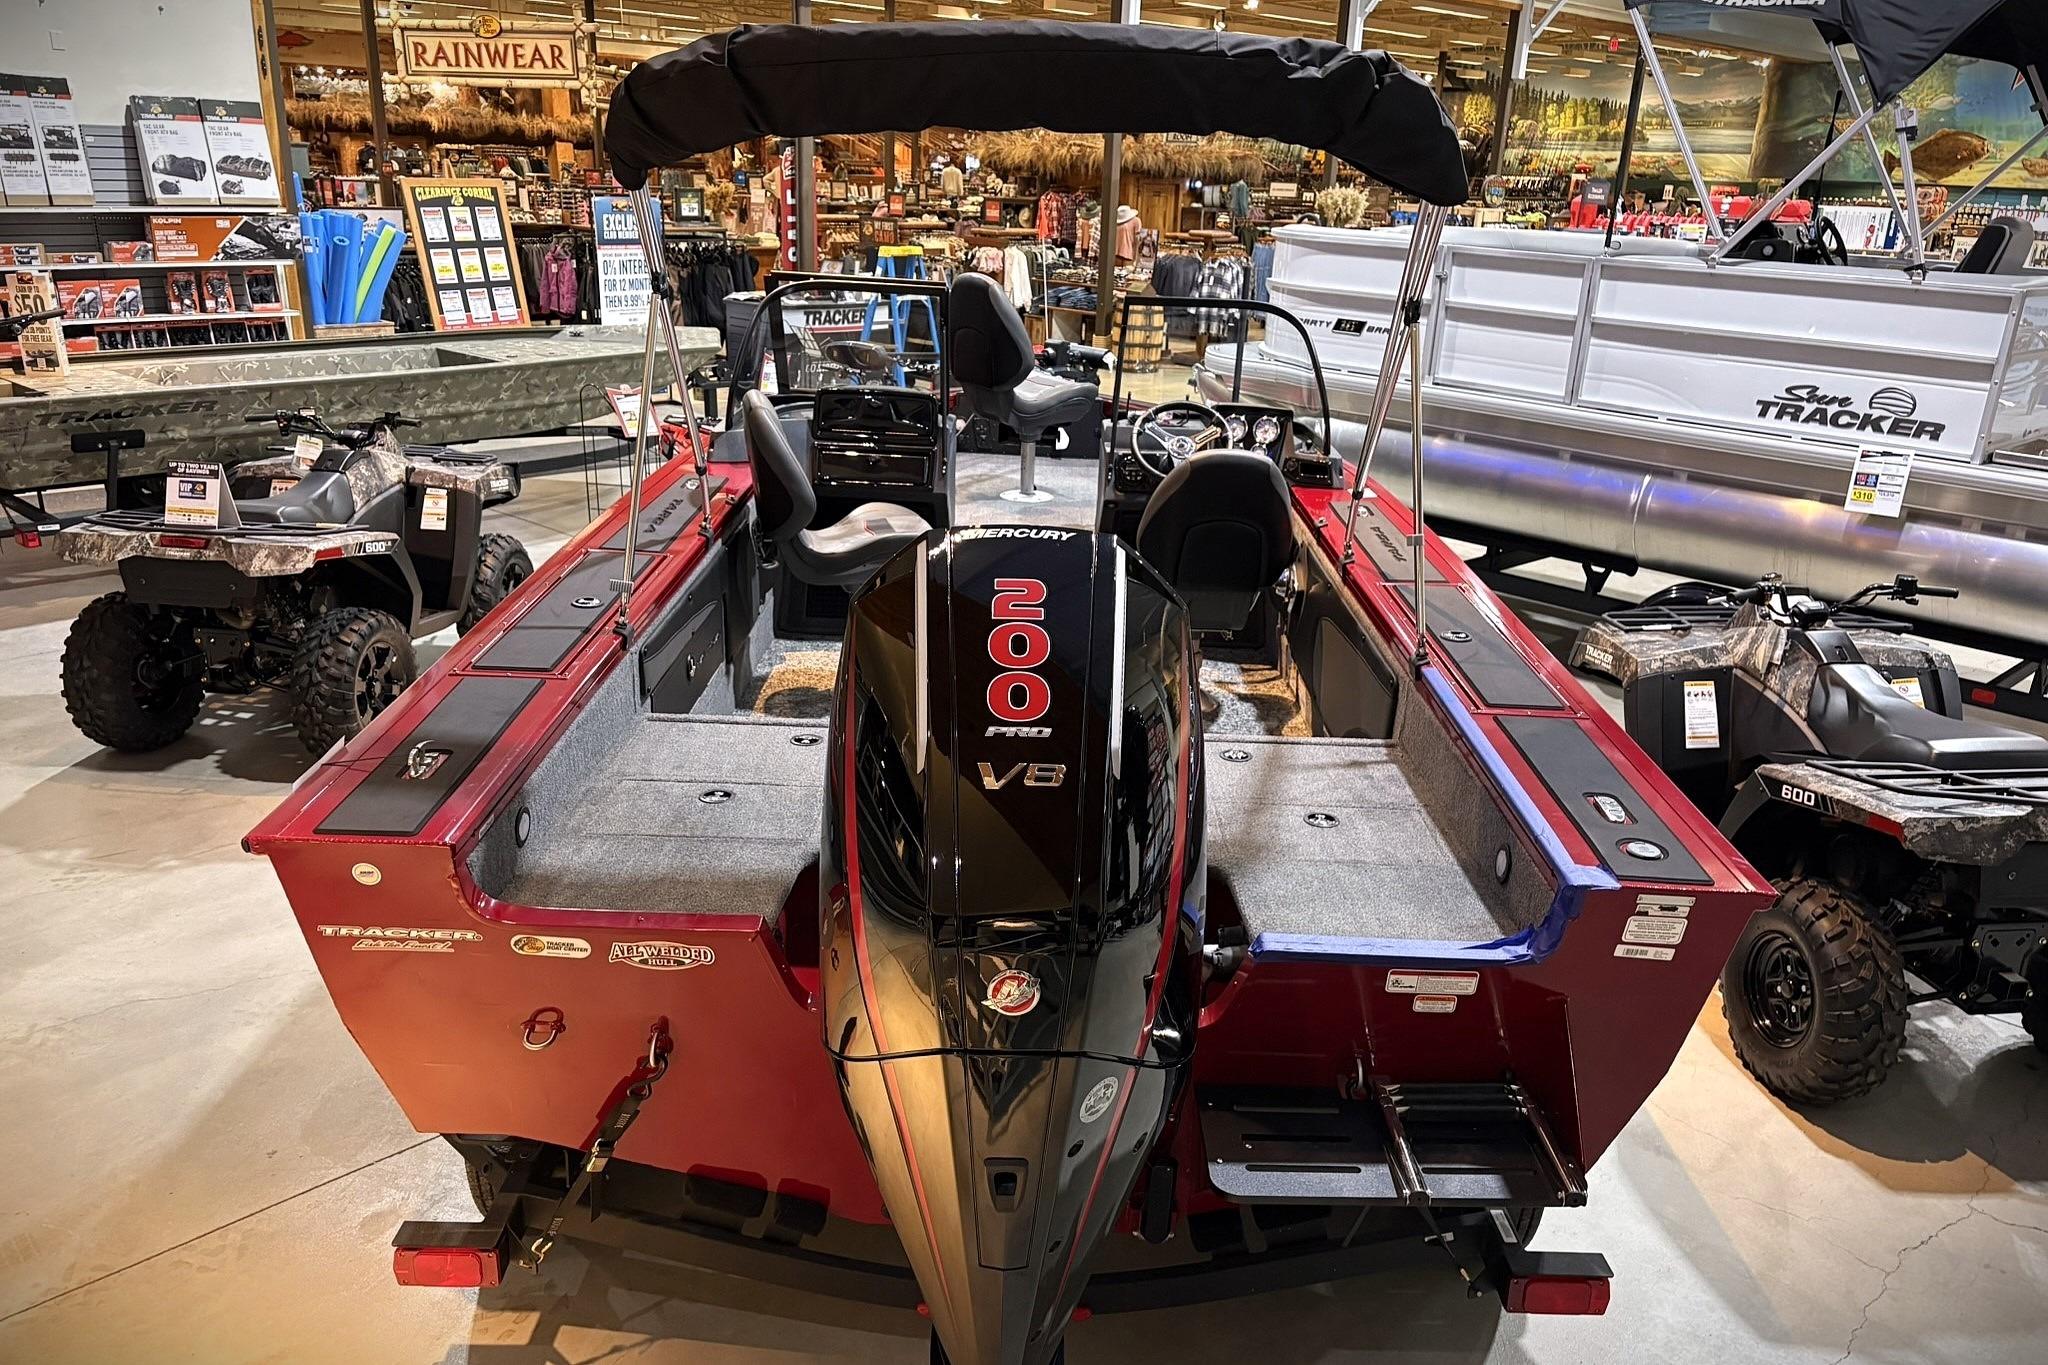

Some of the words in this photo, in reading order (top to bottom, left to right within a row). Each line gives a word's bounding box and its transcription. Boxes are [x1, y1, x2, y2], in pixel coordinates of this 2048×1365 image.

[411, 41, 568, 70] RAINWEAR
[415, 187, 461, 202] CLEARANCE
[463, 187, 495, 202] CORRAL
[875, 230, 896, 243] CAMO
[603, 259, 617, 275] 0%
[604, 279, 617, 292] FOR
[619, 278, 627, 291] 12
[14, 293, 47, 325] $50
[604, 295, 623, 308] THEN
[624, 294, 645, 307] 9.99%
[803, 309, 867, 326] TRACKER
[1773, 384, 1854, 408] Sun
[35, 400, 219, 425] TRACKER
[1756, 399, 1946, 442] TRACKER
[180, 482, 193, 492] VIP
[1853, 491, 1873, 500] $310
[959, 528, 1077, 541] MERCURY
[366, 541, 386, 553] 600
[987, 577, 1051, 723] 200
[1585, 644, 1614, 664] TRACKER
[984, 725, 1053, 738] PRO
[976, 762, 1067, 790] V8
[1780, 784, 1815, 806] 600
[317, 925, 475, 941] TRACKER
[612, 944, 642, 959] ALL
[641, 945, 714, 962] WELDED
[647, 958, 678, 966] HULL
